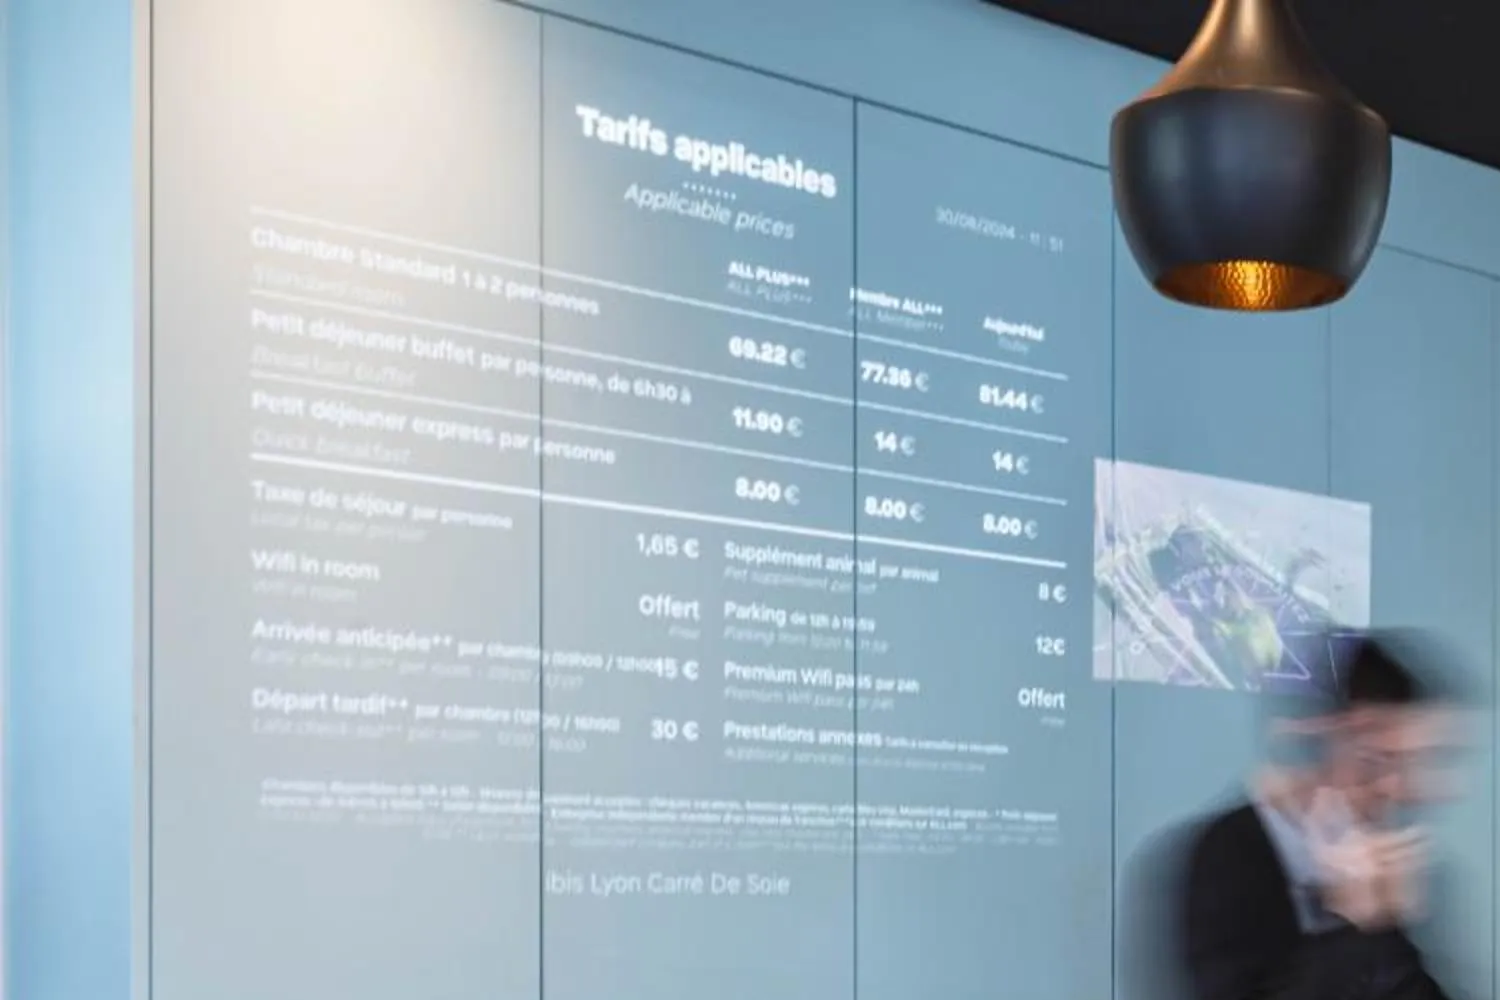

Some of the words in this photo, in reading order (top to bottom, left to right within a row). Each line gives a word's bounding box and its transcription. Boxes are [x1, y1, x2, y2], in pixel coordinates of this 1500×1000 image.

[575, 104, 668, 155] Tarifs
[674, 135, 837, 198] applicables
[624, 183, 732, 226] Applicable
[735, 211, 796, 240] prices
[251, 226, 355, 263] Chambre
[360, 247, 456, 284] Standard
[490, 275, 503, 295] 2
[505, 280, 600, 315] personnes
[728, 260, 754, 279] ALL
[250, 307, 304, 336] Petit
[308, 316, 406, 352] déjeuner
[411, 334, 474, 366] buffet
[481, 351, 512, 373] par
[608, 371, 630, 394] de
[633, 377, 678, 403] 6h30
[728, 336, 788, 367] 69.22
[789, 348, 808, 370] €
[979, 384, 1028, 411] 81.44
[250, 389, 304, 417] Petit
[310, 399, 407, 432] déjeuner
[411, 415, 495, 446] express
[499, 431, 531, 454] par
[732, 406, 784, 435] 11.90
[785, 416, 804, 438] €
[874, 430, 898, 452] 14
[992, 449, 1014, 473] 14
[250, 479, 305, 506] Taxe
[308, 485, 338, 510] de
[342, 491, 408, 518] séjour
[734, 476, 782, 502] 8.00
[783, 484, 801, 506] €
[864, 495, 907, 520] 8.00
[982, 513, 1022, 537] 8.00
[636, 532, 678, 558] 1,65
[682, 537, 700, 559] €
[724, 540, 823, 570] Supplément
[249, 549, 297, 574] Wifi
[300, 553, 319, 575] in
[324, 558, 381, 582] room
[1052, 584, 1068, 603] €
[638, 593, 701, 625] Offert
[723, 601, 787, 628] Parking
[251, 617, 331, 645] Arrivée
[656, 656, 678, 679] 15
[682, 660, 700, 682] €
[723, 660, 798, 684] Premium
[800, 666, 832, 688] Wifi
[252, 687, 328, 714] Départ
[1017, 688, 1067, 711] Offert
[650, 717, 678, 741] 30
[682, 720, 700, 742] €
[723, 720, 816, 745] Prestations
[591, 871, 641, 898] Lyon
[647, 869, 704, 895] Carré
[710, 871, 741, 895] De
[746, 871, 792, 896] Soie
